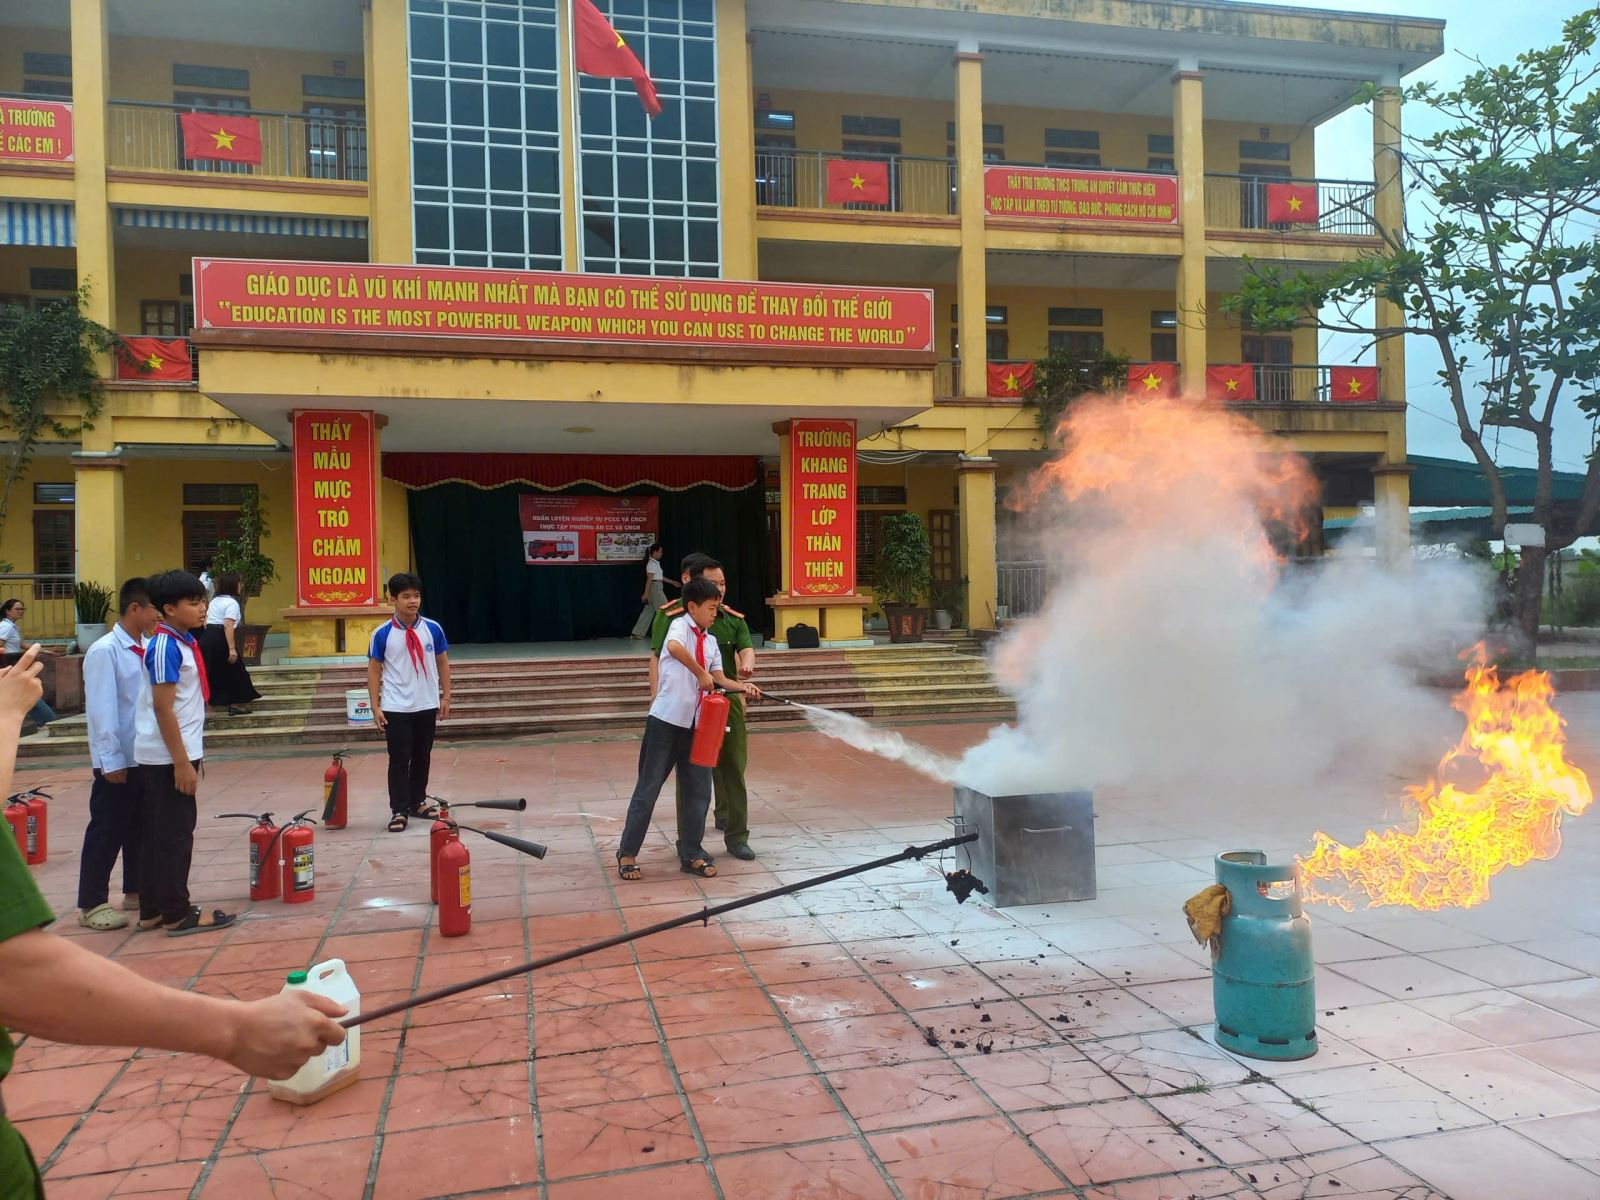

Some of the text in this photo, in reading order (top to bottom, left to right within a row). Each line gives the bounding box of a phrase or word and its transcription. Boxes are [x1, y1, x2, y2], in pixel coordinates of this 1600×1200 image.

[8, 106, 55, 128] TRƯỜNG
[8, 132, 31, 153] CÁC
[35, 137, 53, 154] EM
[246, 271, 892, 320] GIÁO DỤC LÀ VŨ KHÍ MẠNH NHẤT MÀ BẠN CÓ THỂ SỬ DỤNG ĐỂ THAY ĐỔI THẾ GIỚI
[331, 308, 347, 324] IS
[352, 309, 382, 326] THE
[386, 309, 432, 327] MOST
[437, 311, 521, 330] POWERFUL
[526, 314, 592, 333] WEAPON
[597, 318, 646, 335] WHICH
[651, 320, 678, 336] YOU
[683, 321, 713, 338] CAN
[717, 322, 744, 339] USE
[749, 324, 765, 339] TO
[769, 325, 824, 342] CHANGE
[829, 327, 853, 343] THE
[310, 417, 351, 441] THẦY
[797, 427, 851, 448] TRƯỜNG
[313, 445, 351, 470] MẪU
[801, 457, 848, 473] KHANG
[314, 479, 351, 502] MỰC
[802, 483, 847, 500] TRANG
[317, 506, 349, 528] TRÒ
[811, 505, 837, 526] LỚP
[312, 535, 361, 556] CHĂM
[806, 532, 842, 552] THÂN
[308, 567, 366, 585] NGOAN
[804, 558, 844, 581] THIỆN
